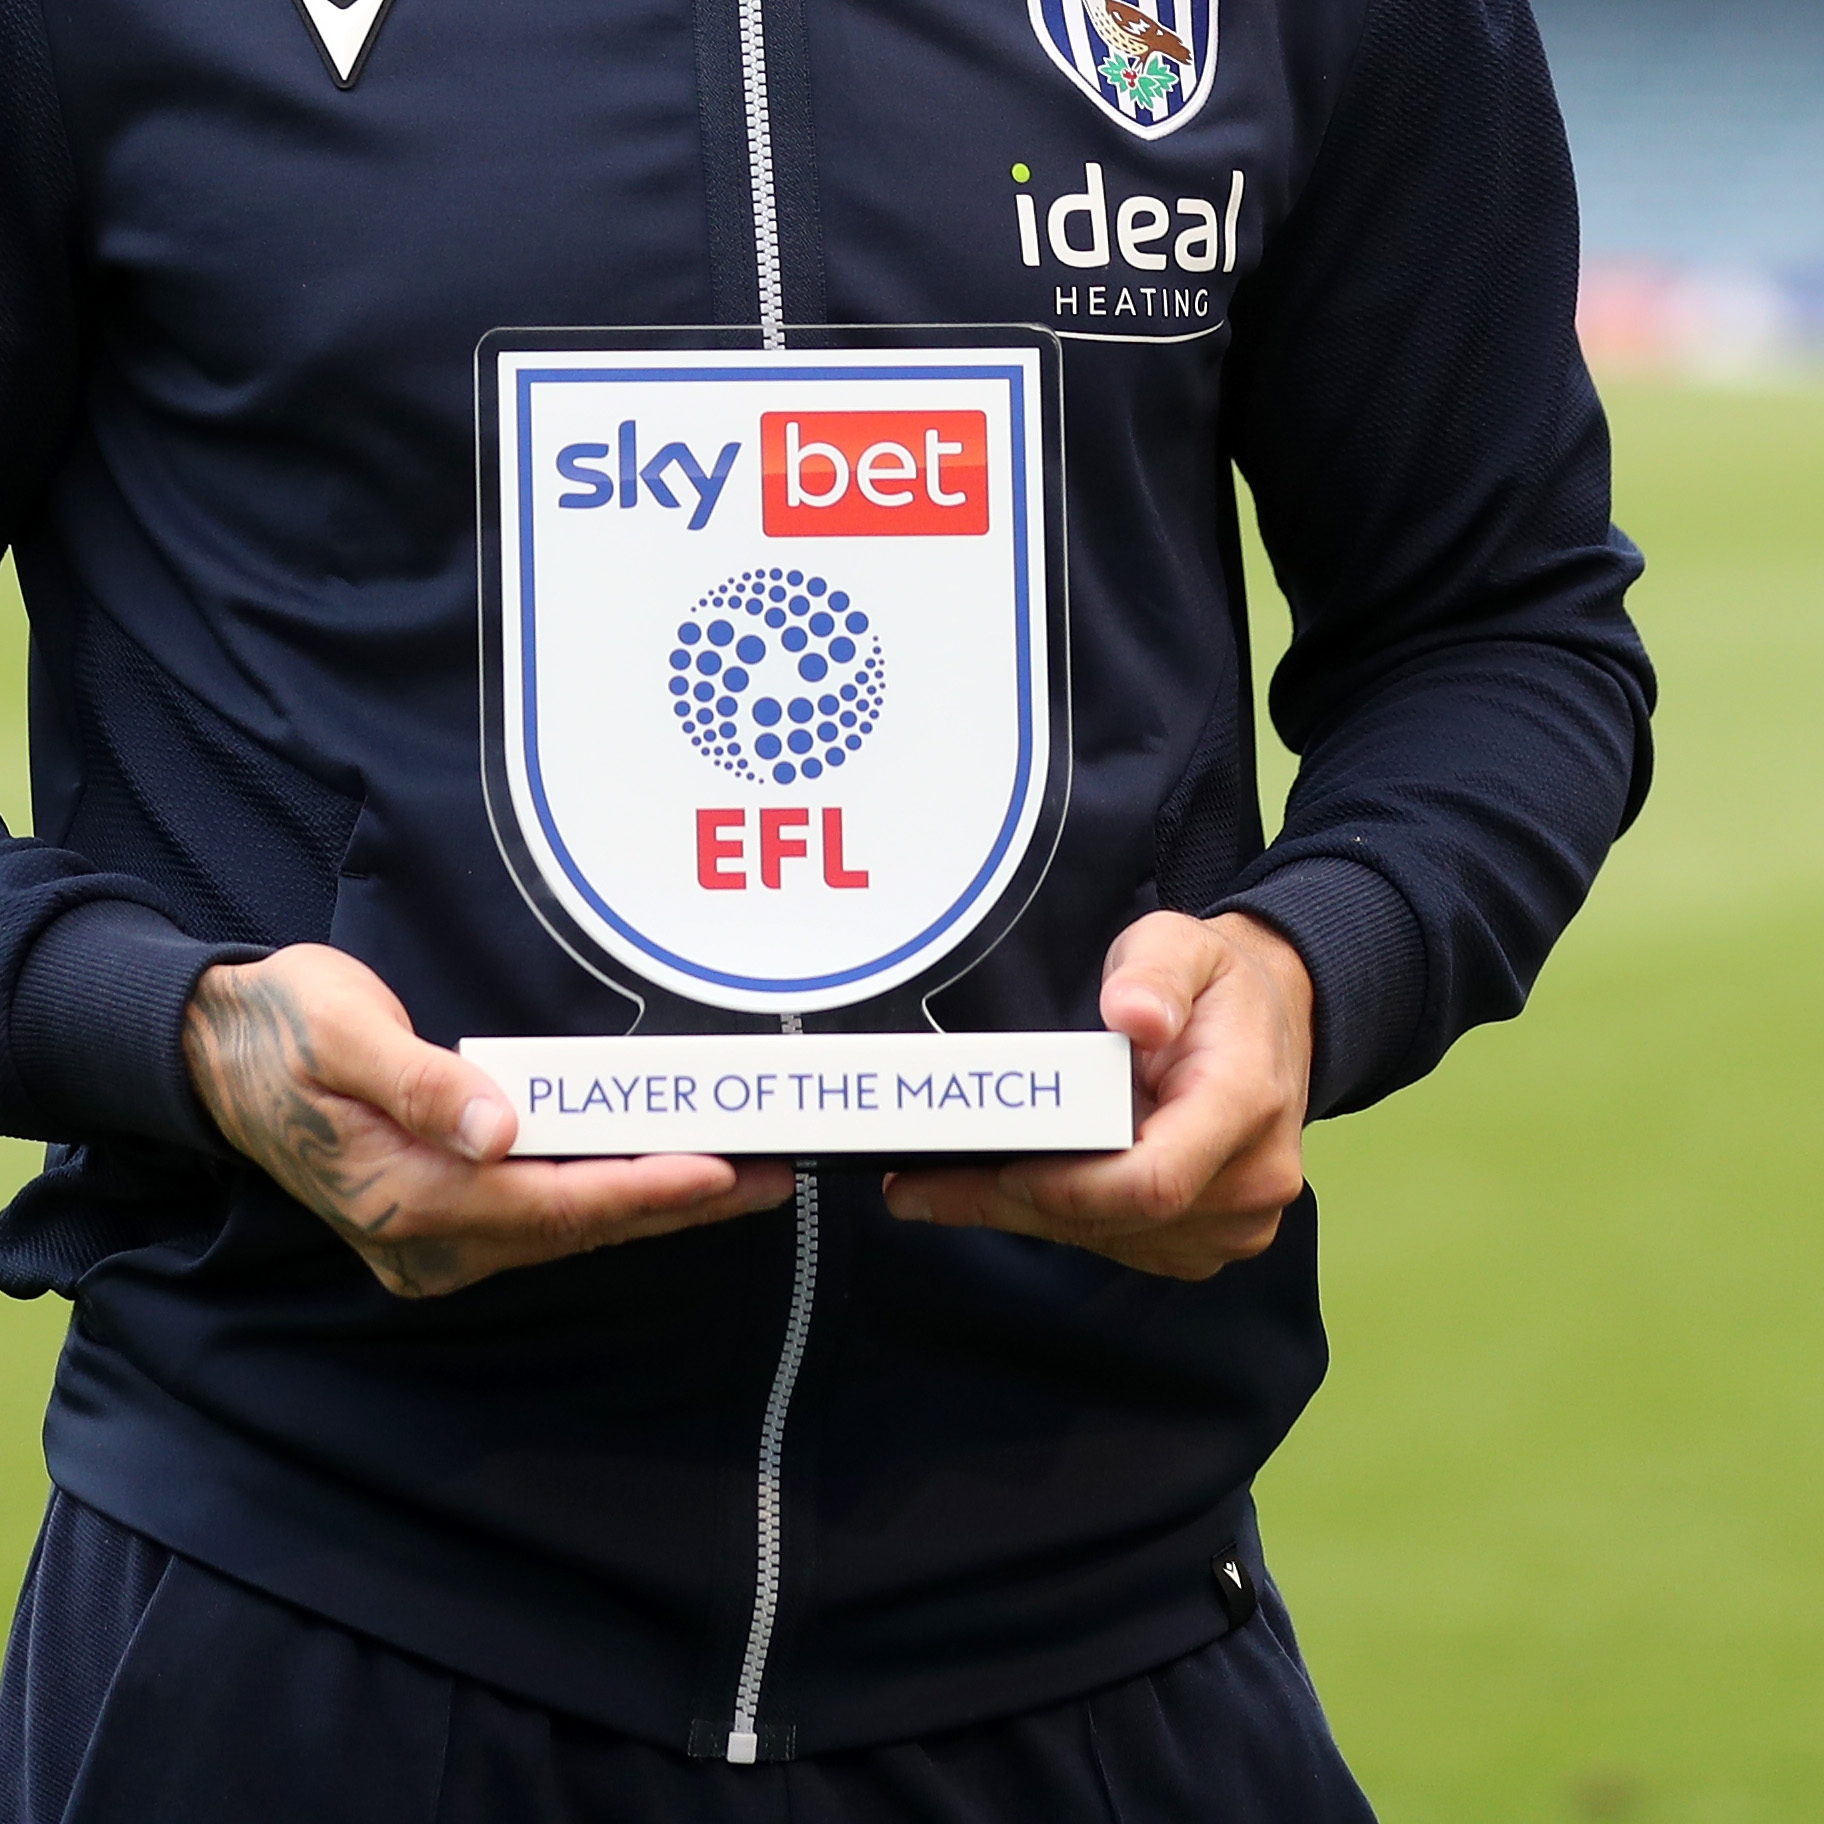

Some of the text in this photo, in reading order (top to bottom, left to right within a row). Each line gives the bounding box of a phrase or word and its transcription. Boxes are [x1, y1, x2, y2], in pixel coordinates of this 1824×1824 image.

[1010, 162, 1245, 273] ideal
[1055, 286, 1209, 318] HEATING
[556, 419, 967, 531] sky bet
[695, 807, 869, 890] EFL
[529, 1071, 1061, 1114] PLAYER OF THE MATCH
